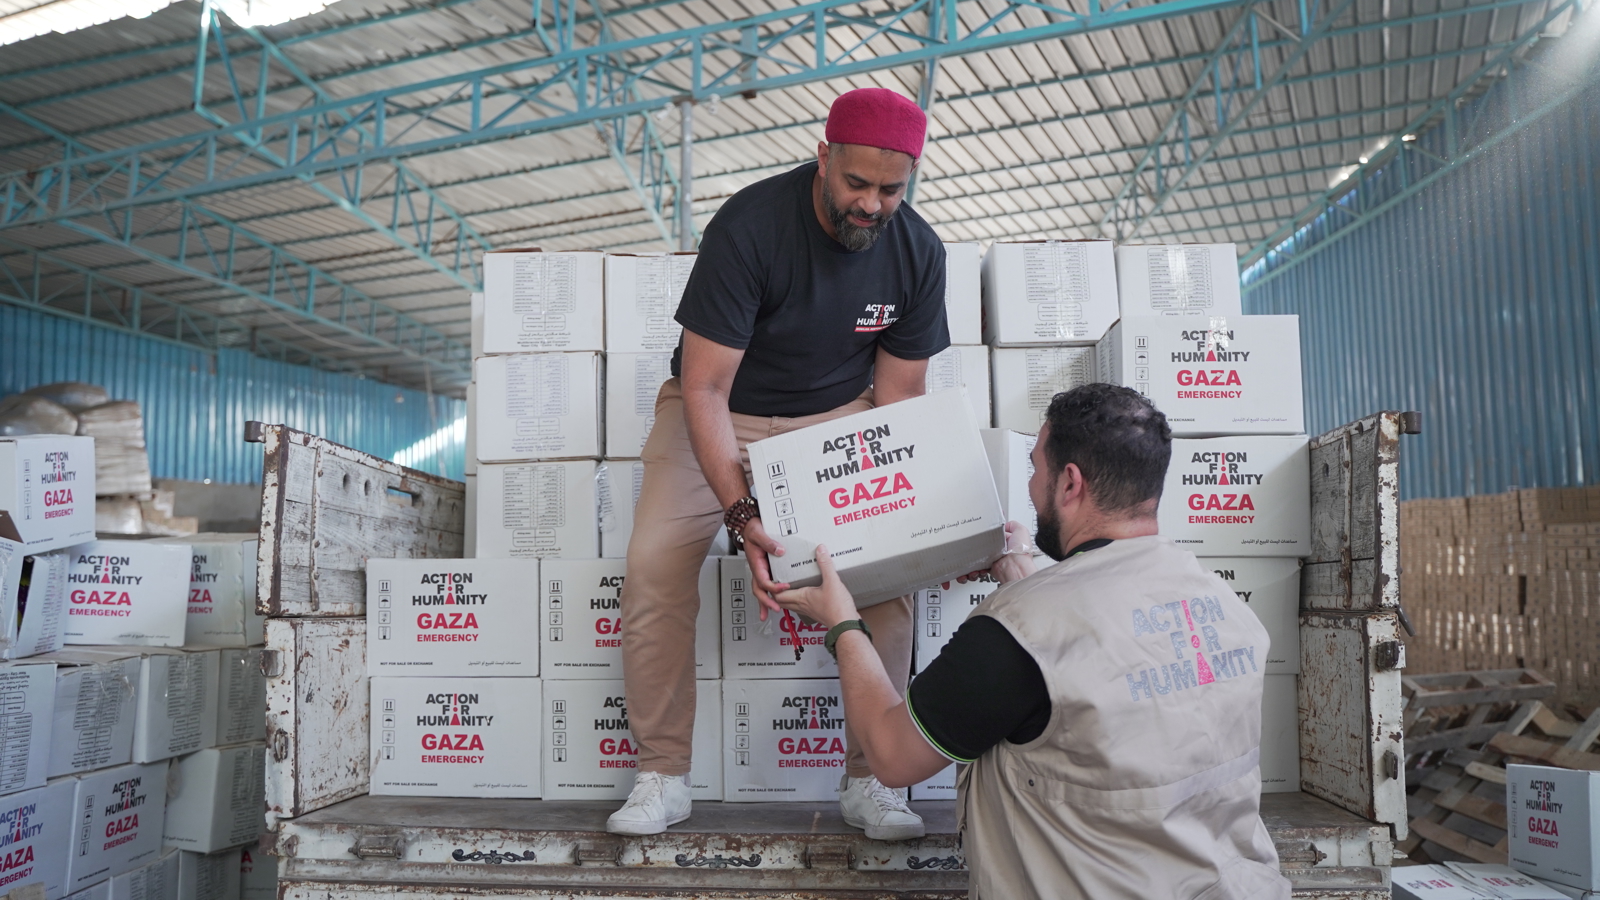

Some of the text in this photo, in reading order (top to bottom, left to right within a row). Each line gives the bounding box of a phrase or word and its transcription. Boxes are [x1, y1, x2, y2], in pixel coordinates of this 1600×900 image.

[1181, 330, 1234, 340] ACTN
[1171, 350, 1250, 362] HUMANITY
[1177, 370, 1241, 386] GAZA
[816, 445, 915, 483] HUMANITY
[41, 471, 76, 484] HUMANITY
[1182, 473, 1263, 485] HUMANITY
[44, 489, 73, 506] GAZA
[829, 472, 914, 509] GAZA
[1188, 494, 1254, 510] GAZA
[44, 508, 74, 519] EMERGENCY
[833, 496, 916, 526] EMERGENCY
[68, 574, 142, 585] HUMANITY
[190, 573, 218, 582] ANITY
[599, 576, 625, 587] ACT
[70, 590, 132, 606] GAZA
[188, 589, 212, 603] ZA
[412, 593, 487, 605] HUMANITY
[69, 608, 131, 616] EMERGENCY
[417, 613, 478, 629] GAZA
[595, 618, 622, 634] GA
[1126, 646, 1258, 702] HUMANITY
[417, 714, 493, 726] HUMANITY
[773, 717, 844, 730] HUMANIT
[422, 734, 484, 750] GAZA
[600, 738, 638, 755] GA
[778, 738, 845, 754] GAZA
[600, 760, 636, 768] EMERG
[778, 759, 845, 767] EMERGENCY
[105, 794, 147, 816] HUMANITY
[1526, 799, 1563, 814] HUMANITY
[106, 813, 138, 838] GAZA
[1528, 816, 1559, 836] GAZA
[0, 823, 43, 848] UMANITY
[104, 832, 138, 851] EMERGENCY
[1528, 836, 1559, 849] EMERGENCY
[0, 845, 34, 873] AZA
[0, 866, 33, 887] ERGENCY
